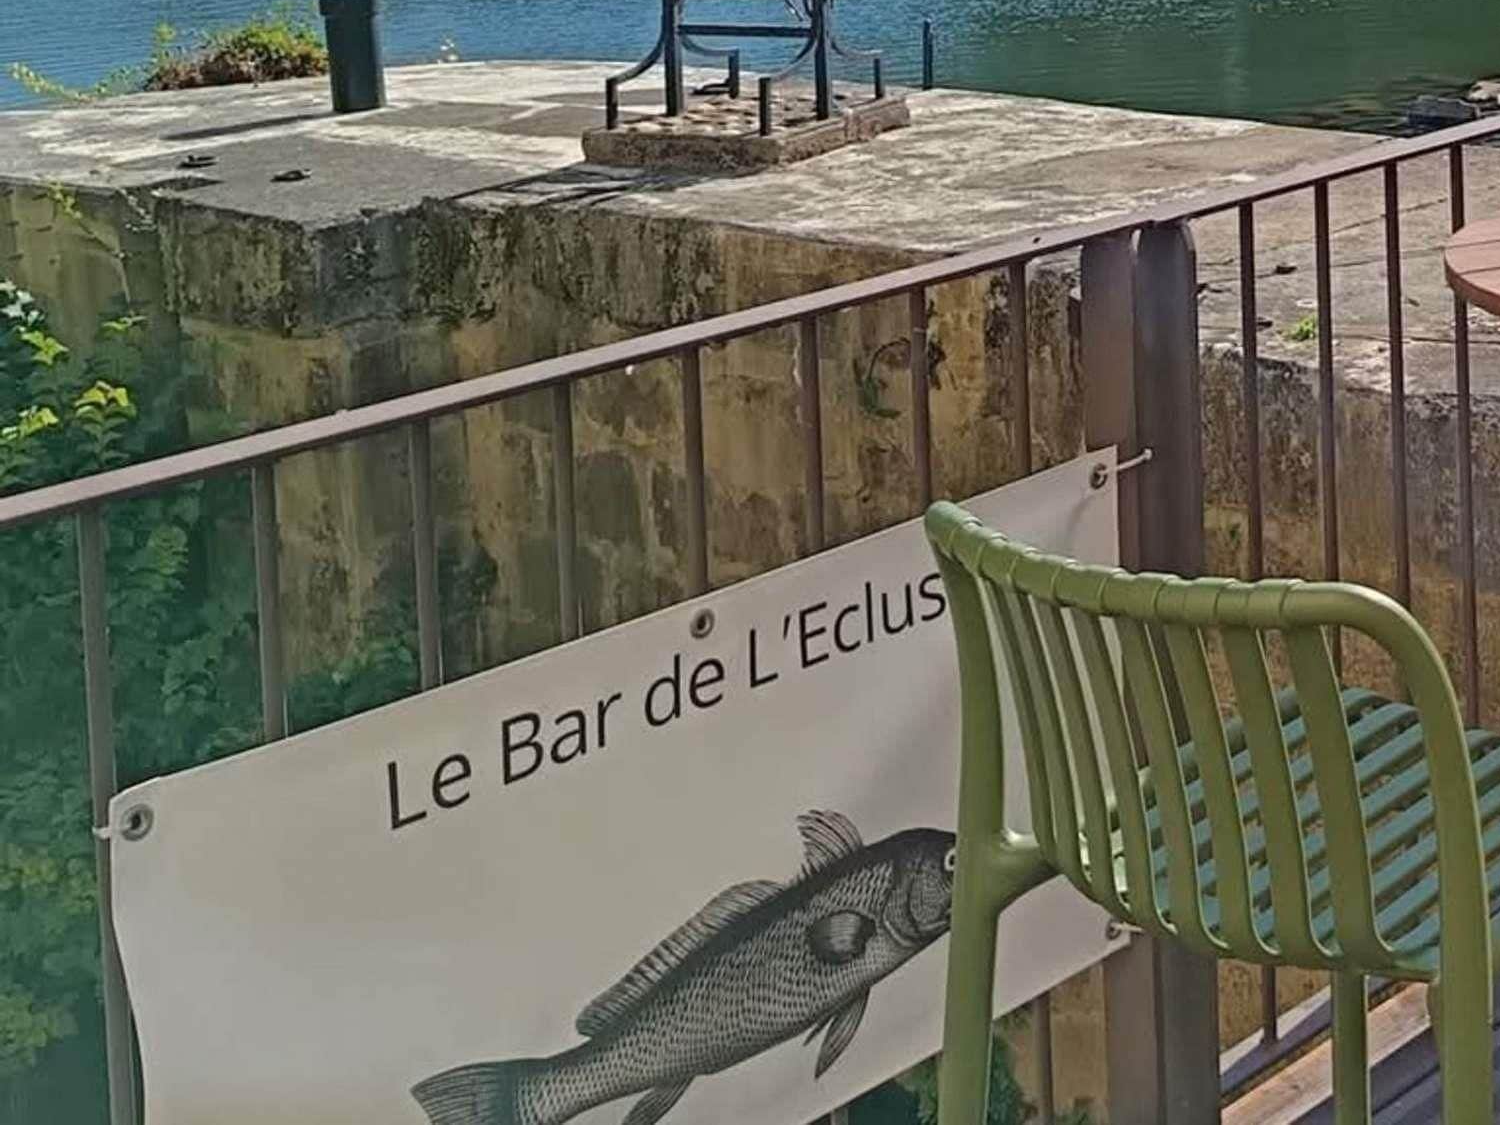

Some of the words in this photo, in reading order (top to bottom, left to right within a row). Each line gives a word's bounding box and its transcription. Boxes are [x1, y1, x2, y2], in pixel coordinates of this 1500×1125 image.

[386, 751, 472, 831] Le
[502, 691, 623, 785] Bar
[643, 653, 726, 727] de
[748, 572, 947, 689] L'Eclus
